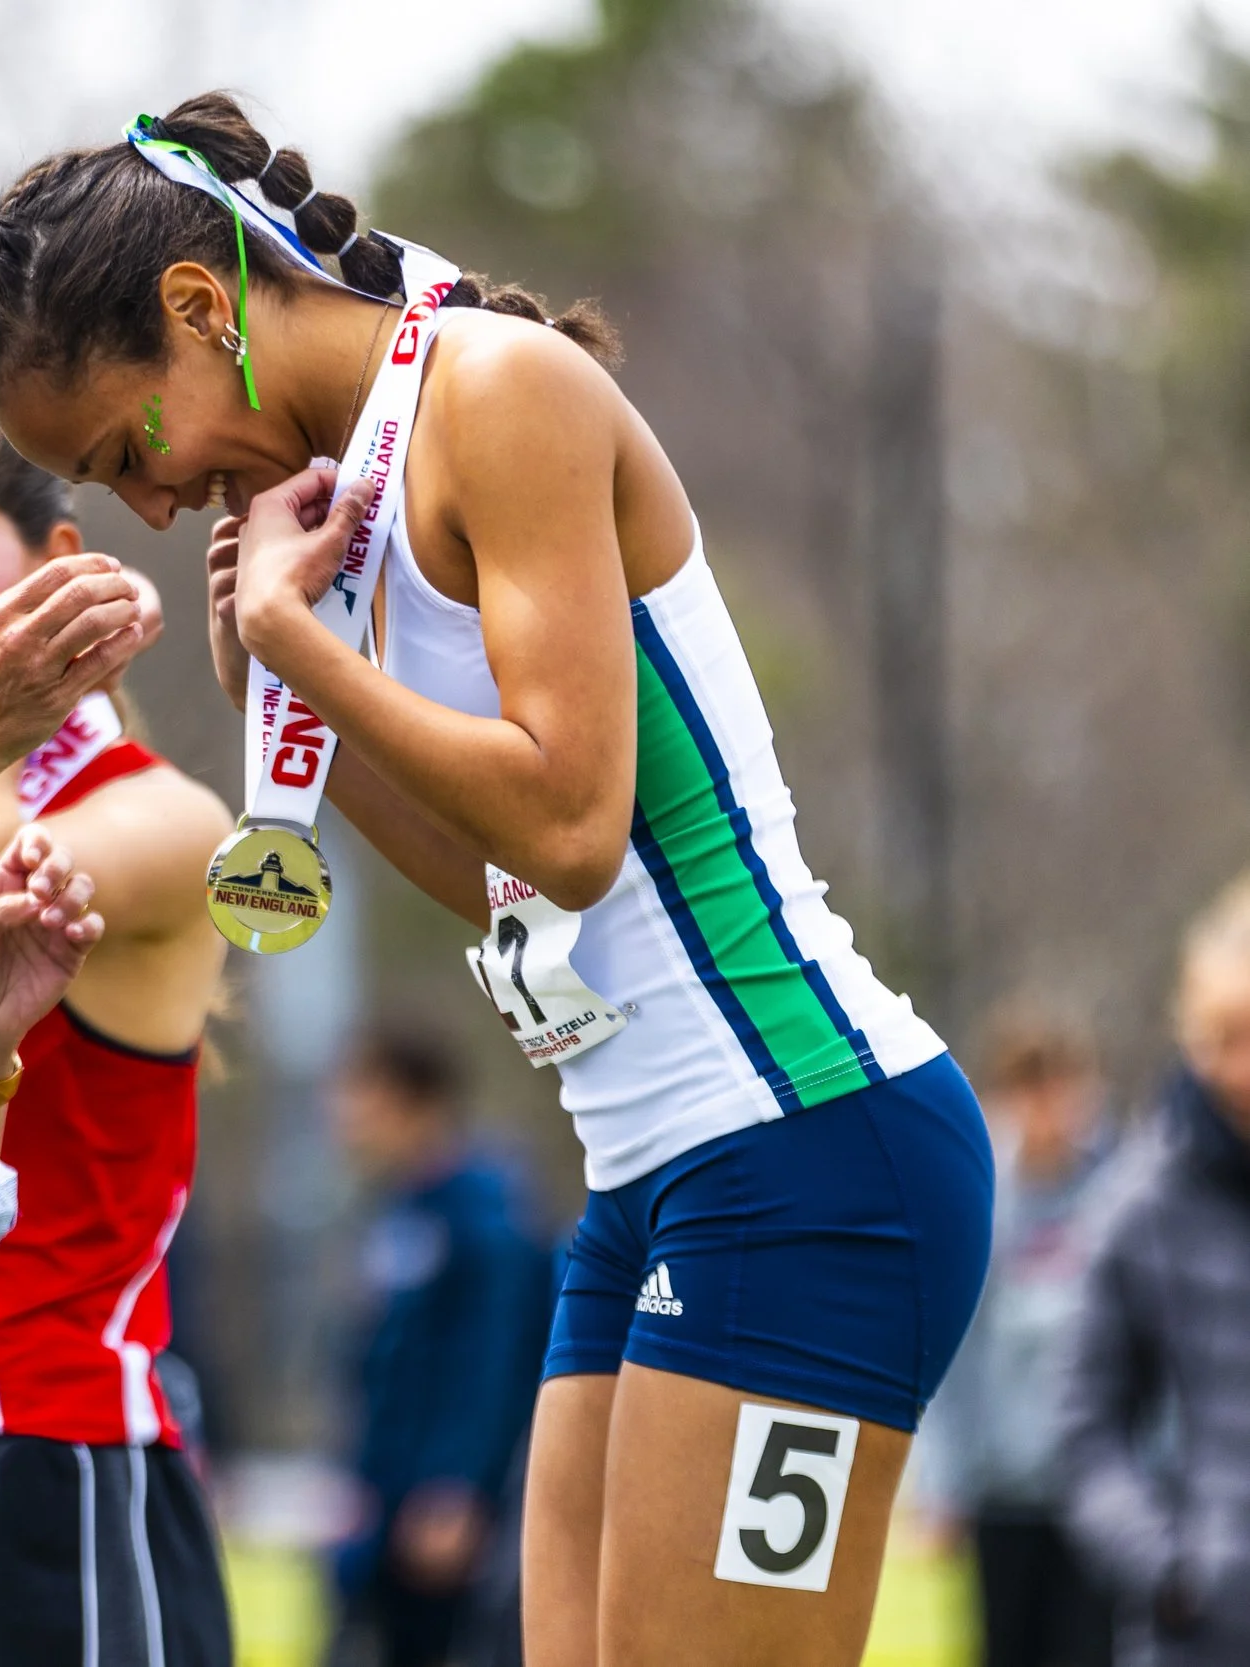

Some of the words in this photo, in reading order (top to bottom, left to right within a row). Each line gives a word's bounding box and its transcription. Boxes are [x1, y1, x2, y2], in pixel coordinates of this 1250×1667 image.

[368, 439, 377, 456] OF
[343, 524, 373, 576] NEW
[271, 691, 327, 789] CN
[215, 889, 249, 907] NEW
[250, 896, 319, 918] ENGLAND
[231, 885, 291, 899] CONFERENCE
[546, 1031, 558, 1042] &
[555, 1010, 597, 1038] FIELD
[635, 1294, 684, 1316] adidas
[738, 1421, 841, 1576] 5
